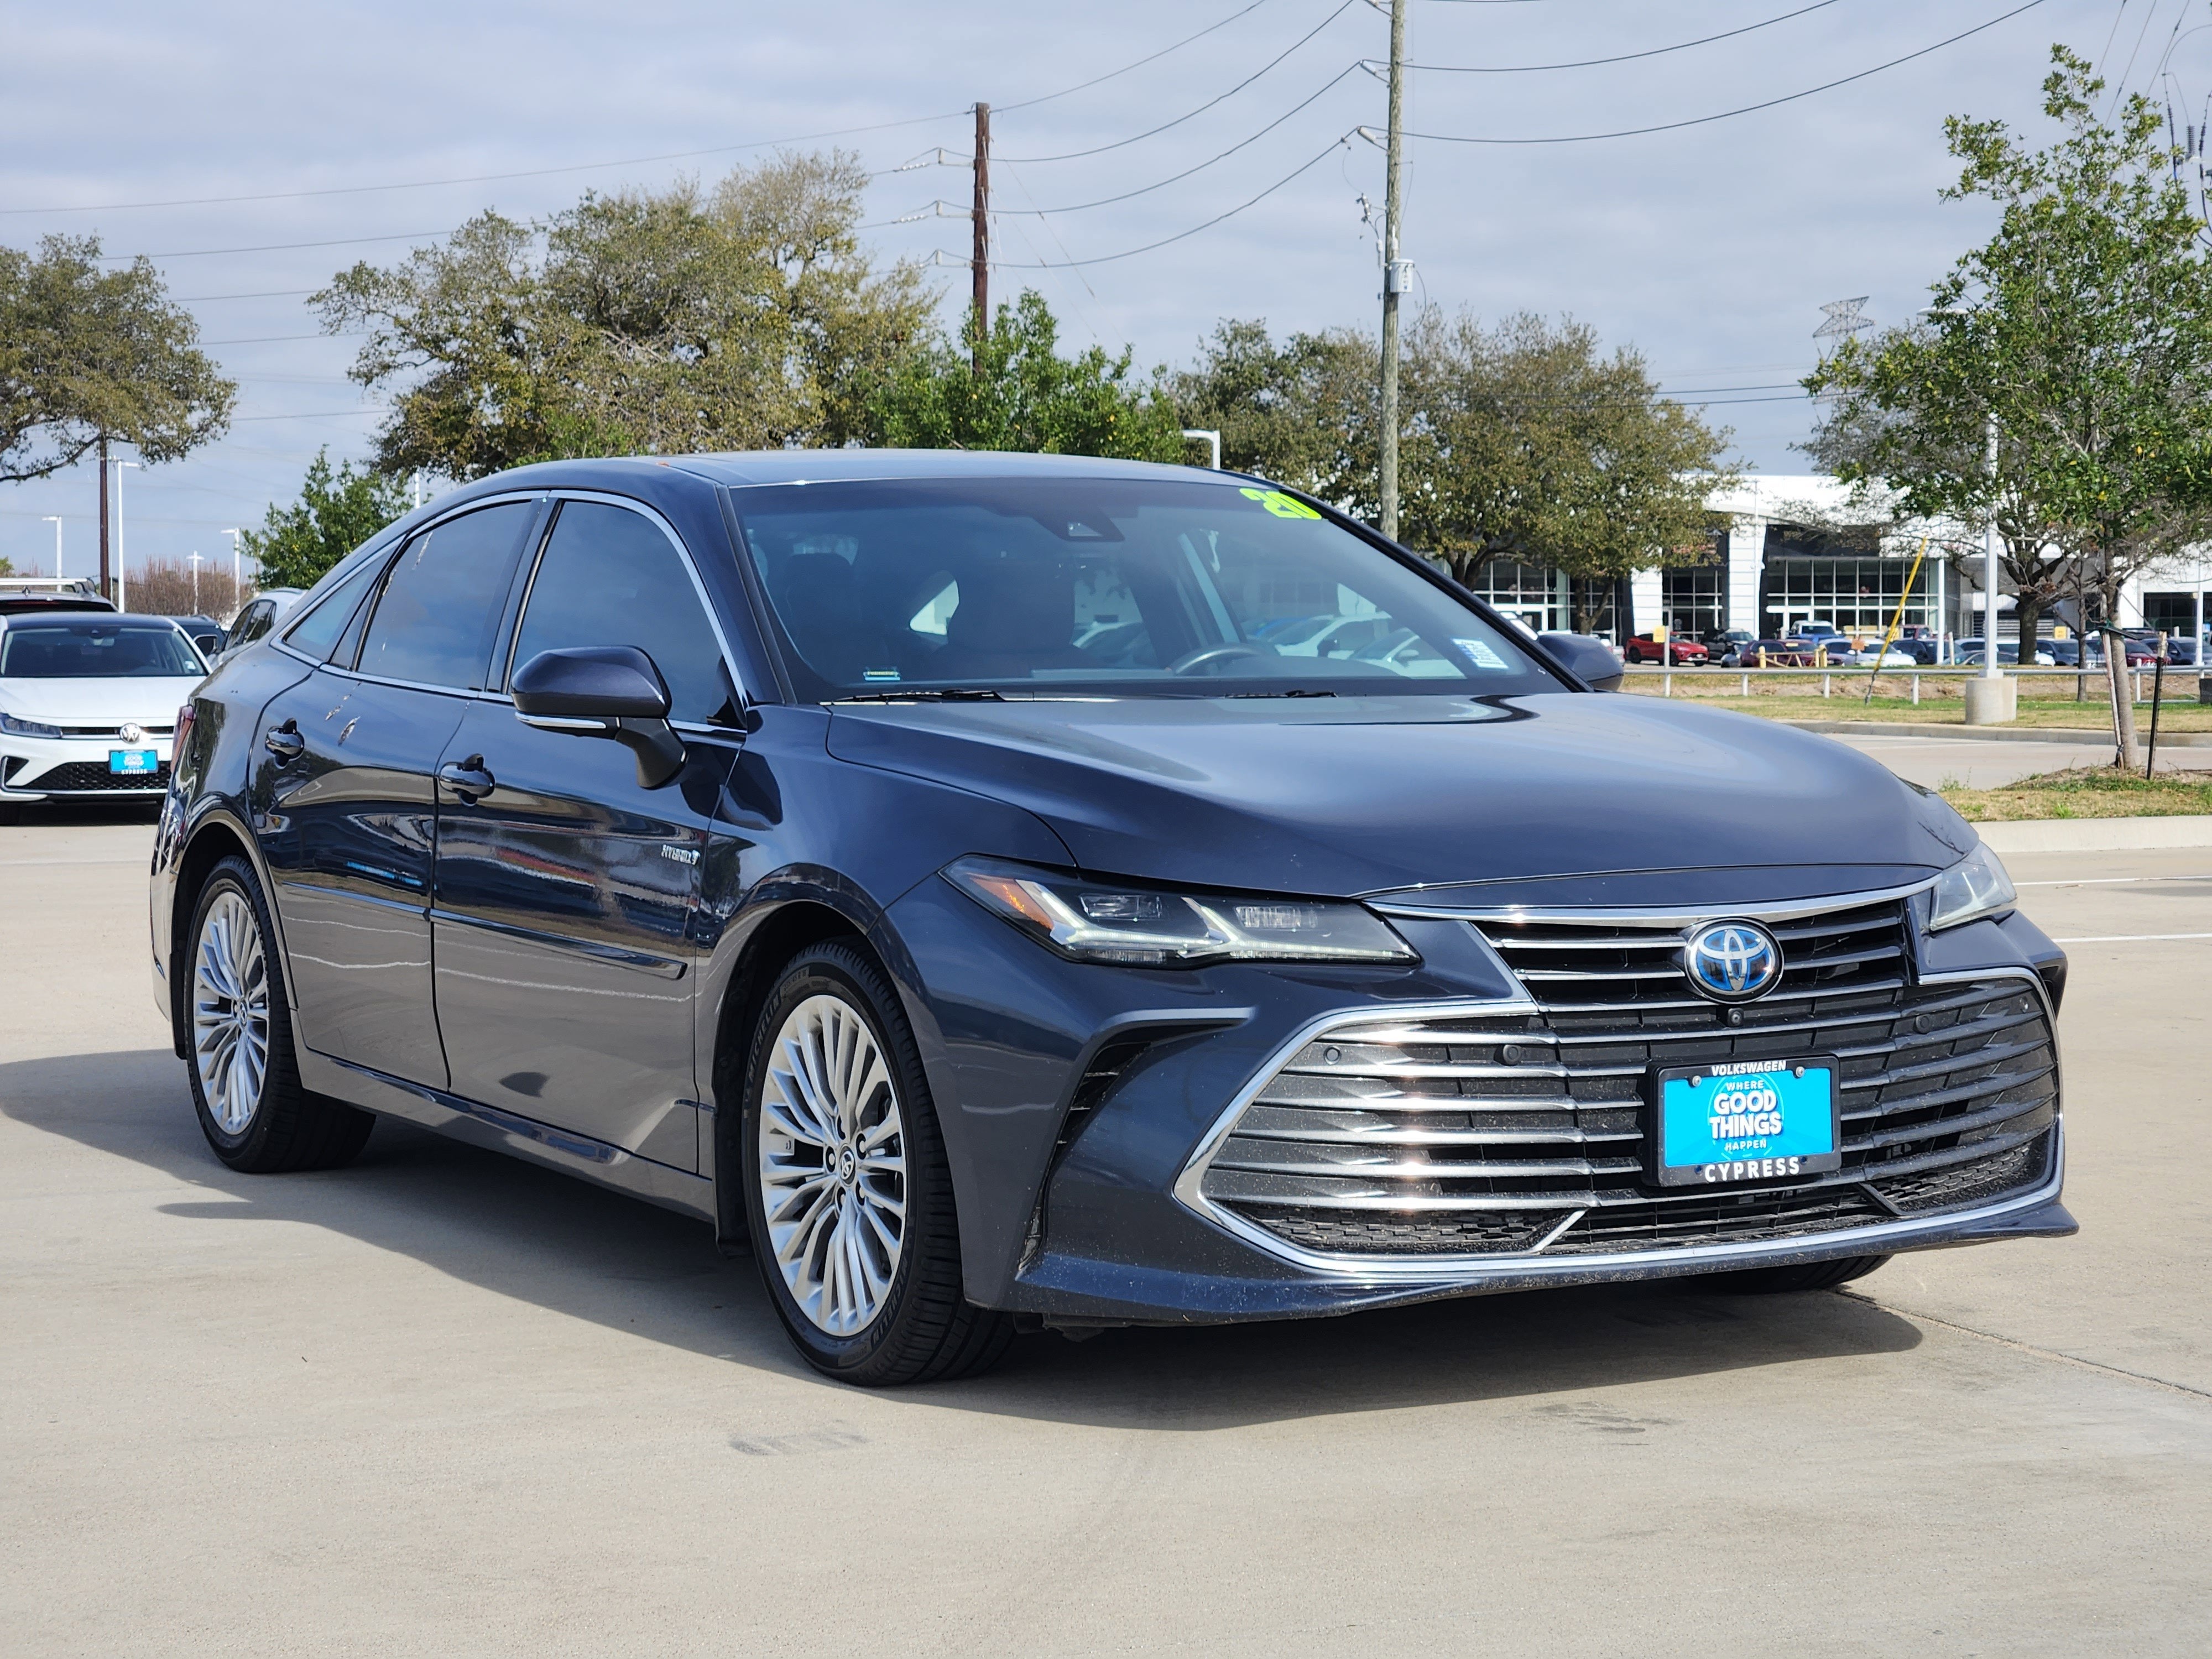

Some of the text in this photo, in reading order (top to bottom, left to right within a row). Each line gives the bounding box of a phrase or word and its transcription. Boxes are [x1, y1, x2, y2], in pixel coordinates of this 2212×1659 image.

[661, 844, 692, 864] HYBRID
[749, 993, 780, 1083] MICHELIN
[1712, 1060, 1786, 1076] VOLKSWAGEN
[1725, 1080, 1765, 1092] WHERE
[1714, 1089, 1777, 1115] GOOD
[1709, 1113, 1783, 1139] THINGS
[1724, 1139, 1767, 1151] HAPPEN
[1704, 1156, 1799, 1182] CYPRESS
